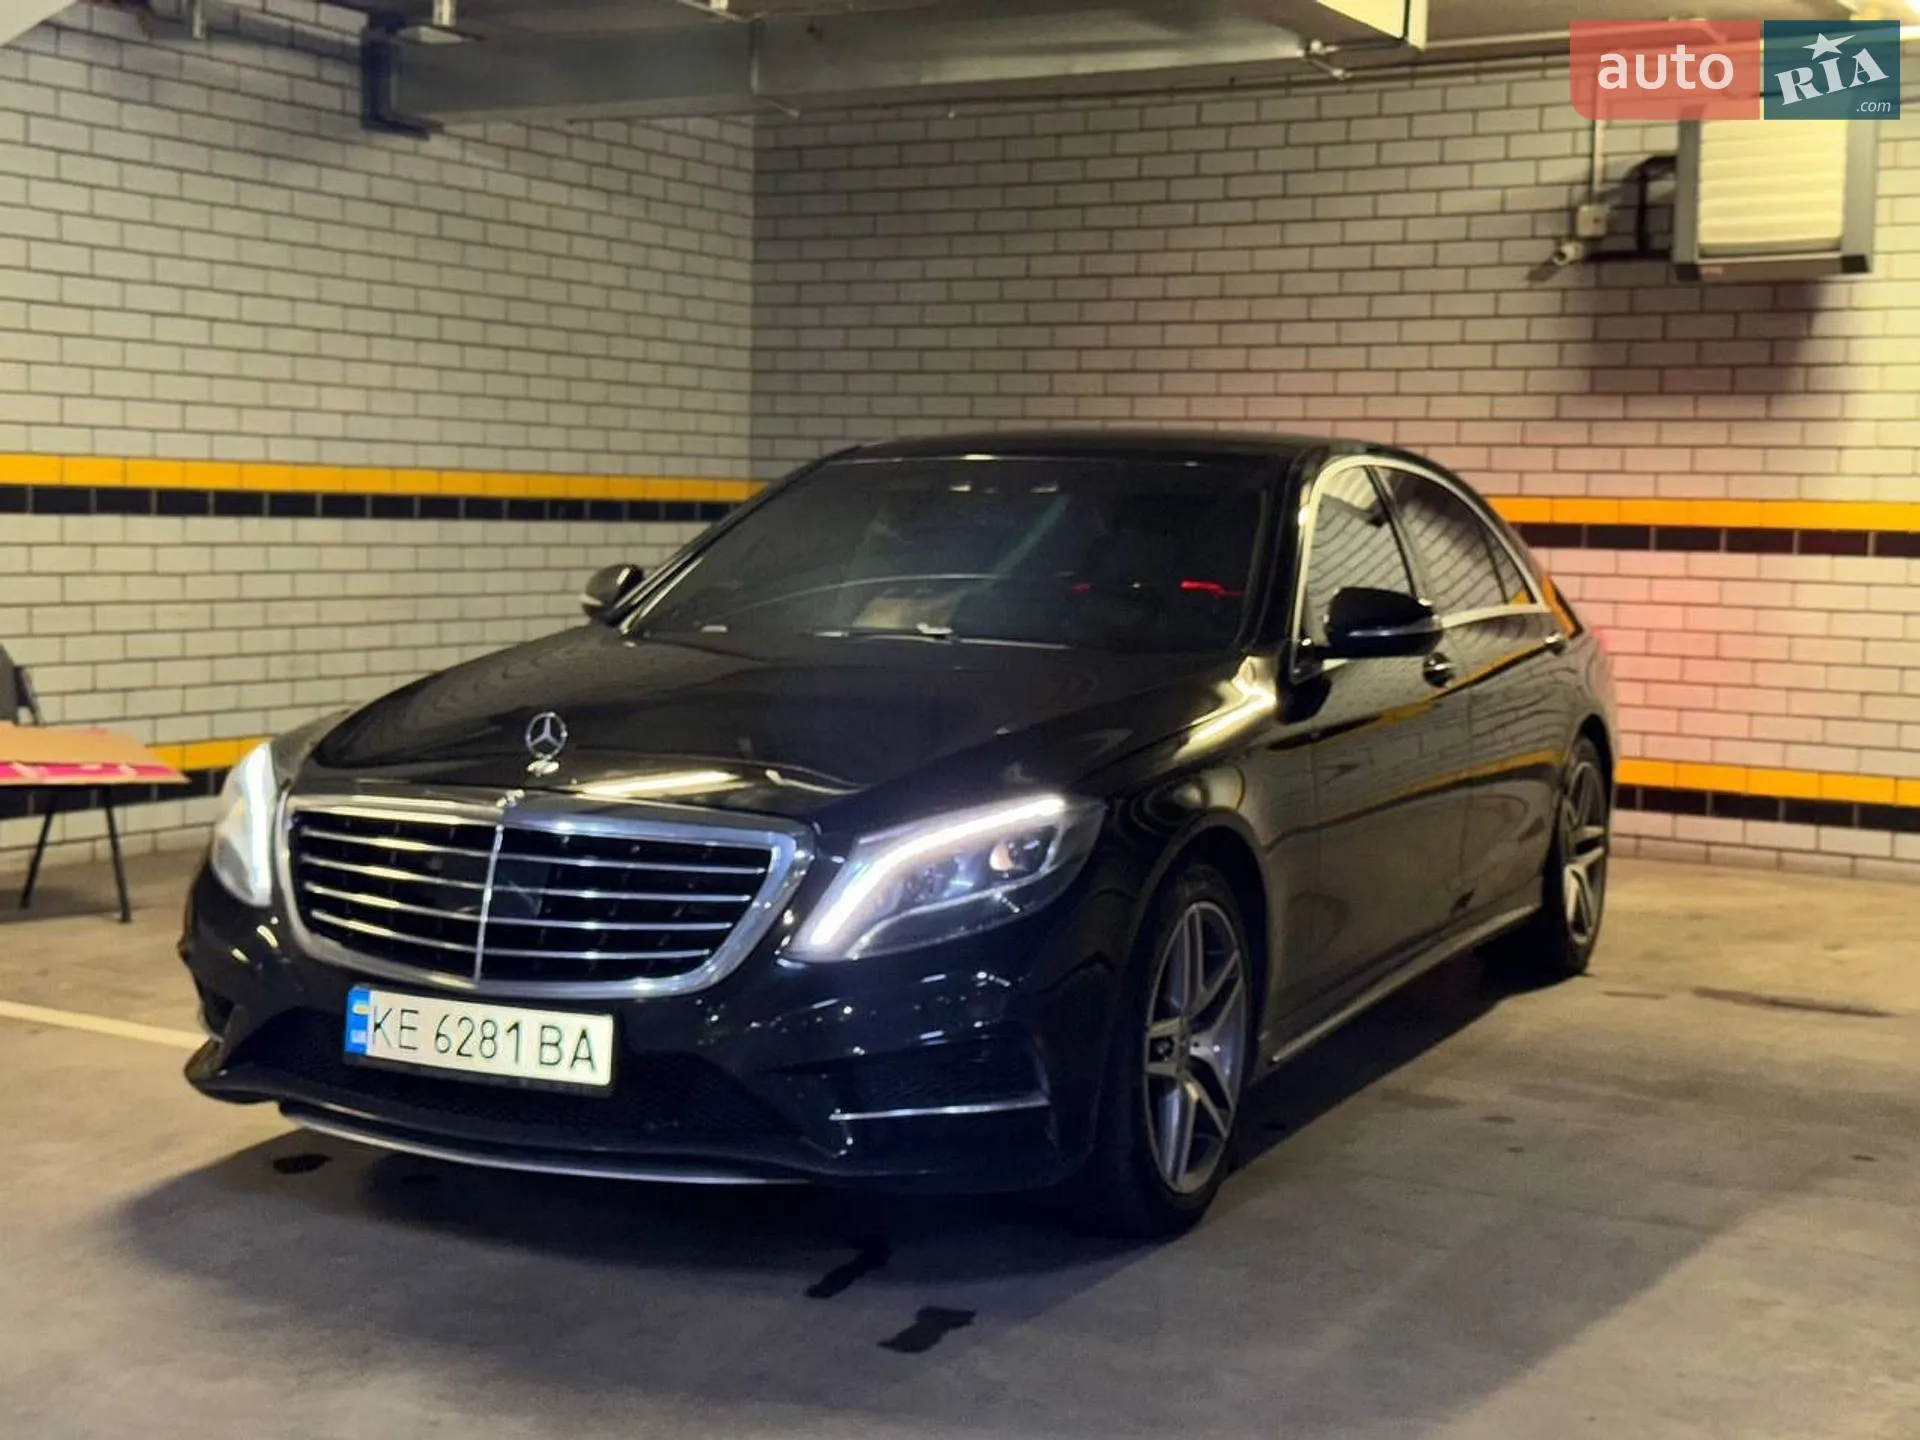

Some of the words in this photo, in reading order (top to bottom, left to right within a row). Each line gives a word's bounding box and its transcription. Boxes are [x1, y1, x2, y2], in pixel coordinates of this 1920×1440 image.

[372, 1006, 419, 1050] KE
[435, 1014, 521, 1064] 6281
[540, 1025, 595, 1071] BA
